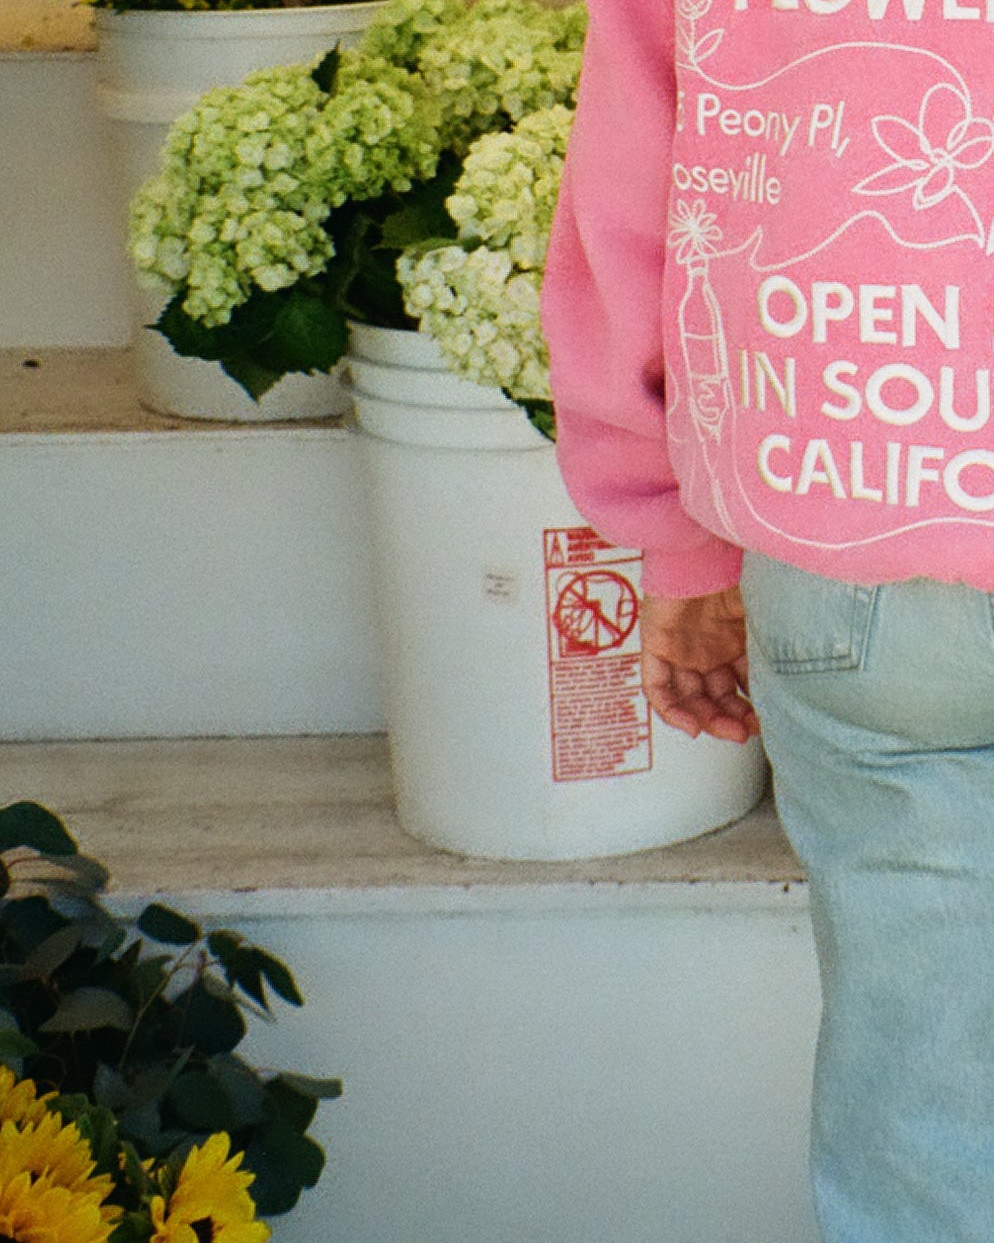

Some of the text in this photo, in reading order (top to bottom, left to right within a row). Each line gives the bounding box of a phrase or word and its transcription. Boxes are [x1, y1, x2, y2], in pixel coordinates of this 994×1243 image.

[697, 92, 802, 157] Peony
[756, 275, 962, 350] OPEN
[740, 348, 797, 418] IN
